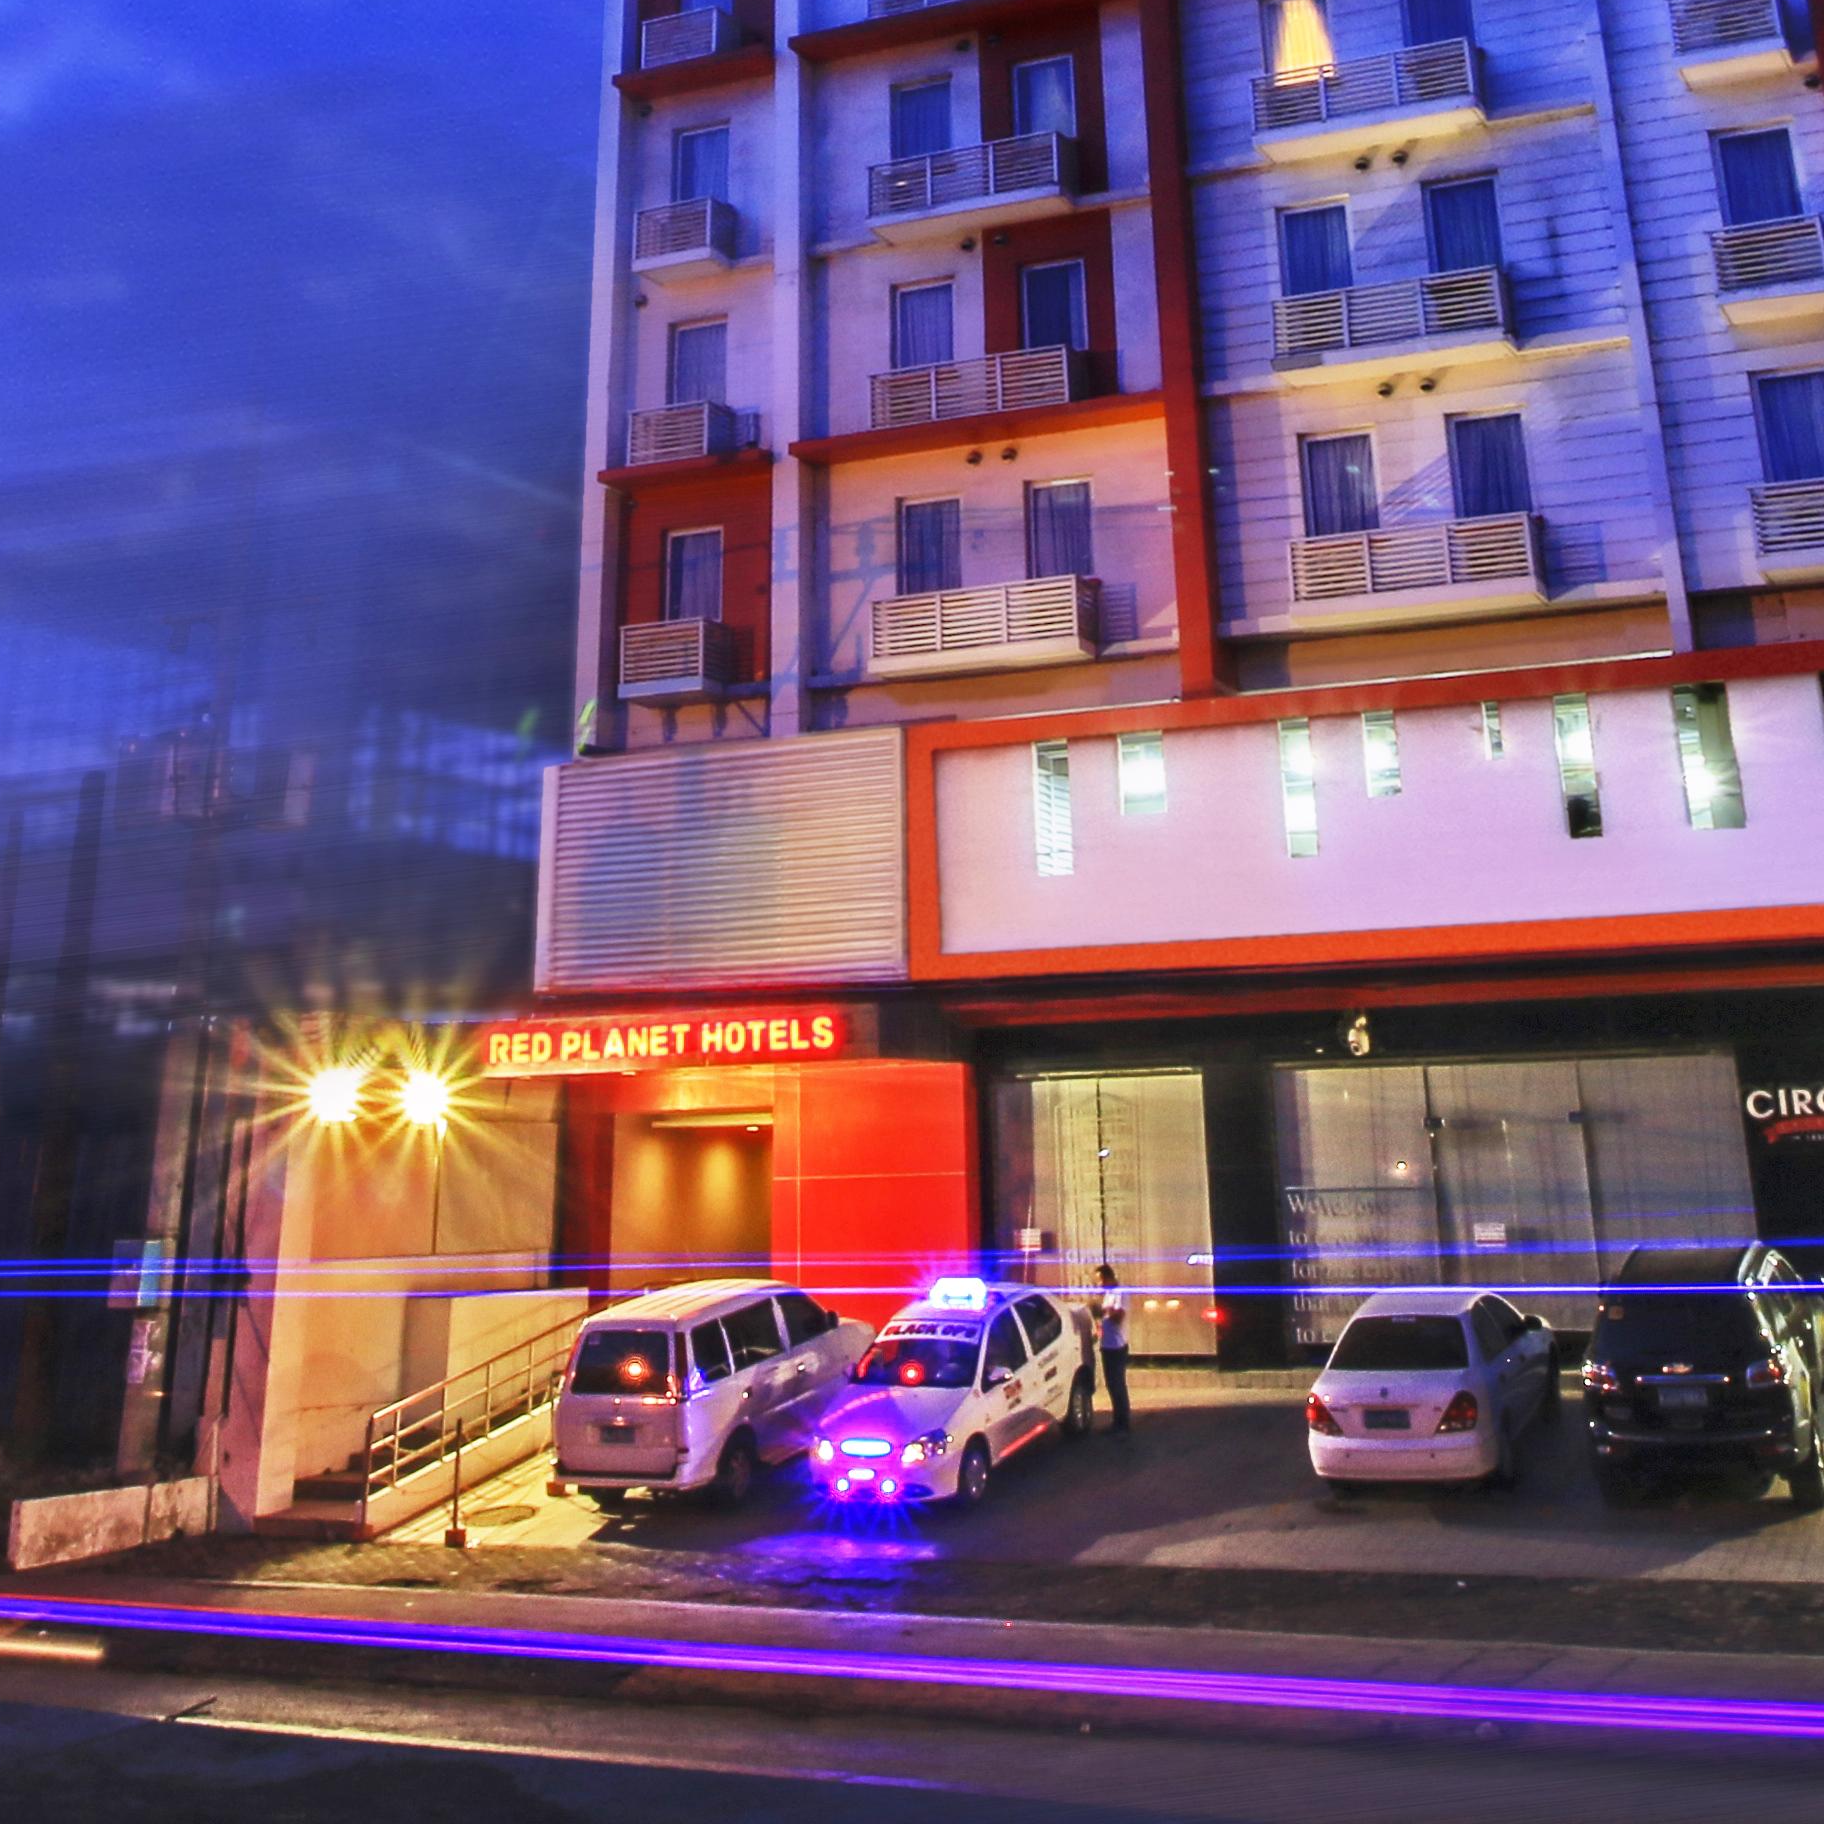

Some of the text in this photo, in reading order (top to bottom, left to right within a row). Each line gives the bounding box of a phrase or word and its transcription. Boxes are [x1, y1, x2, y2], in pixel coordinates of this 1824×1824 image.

[488, 1016, 835, 1065] RED PLANET HOTELS
